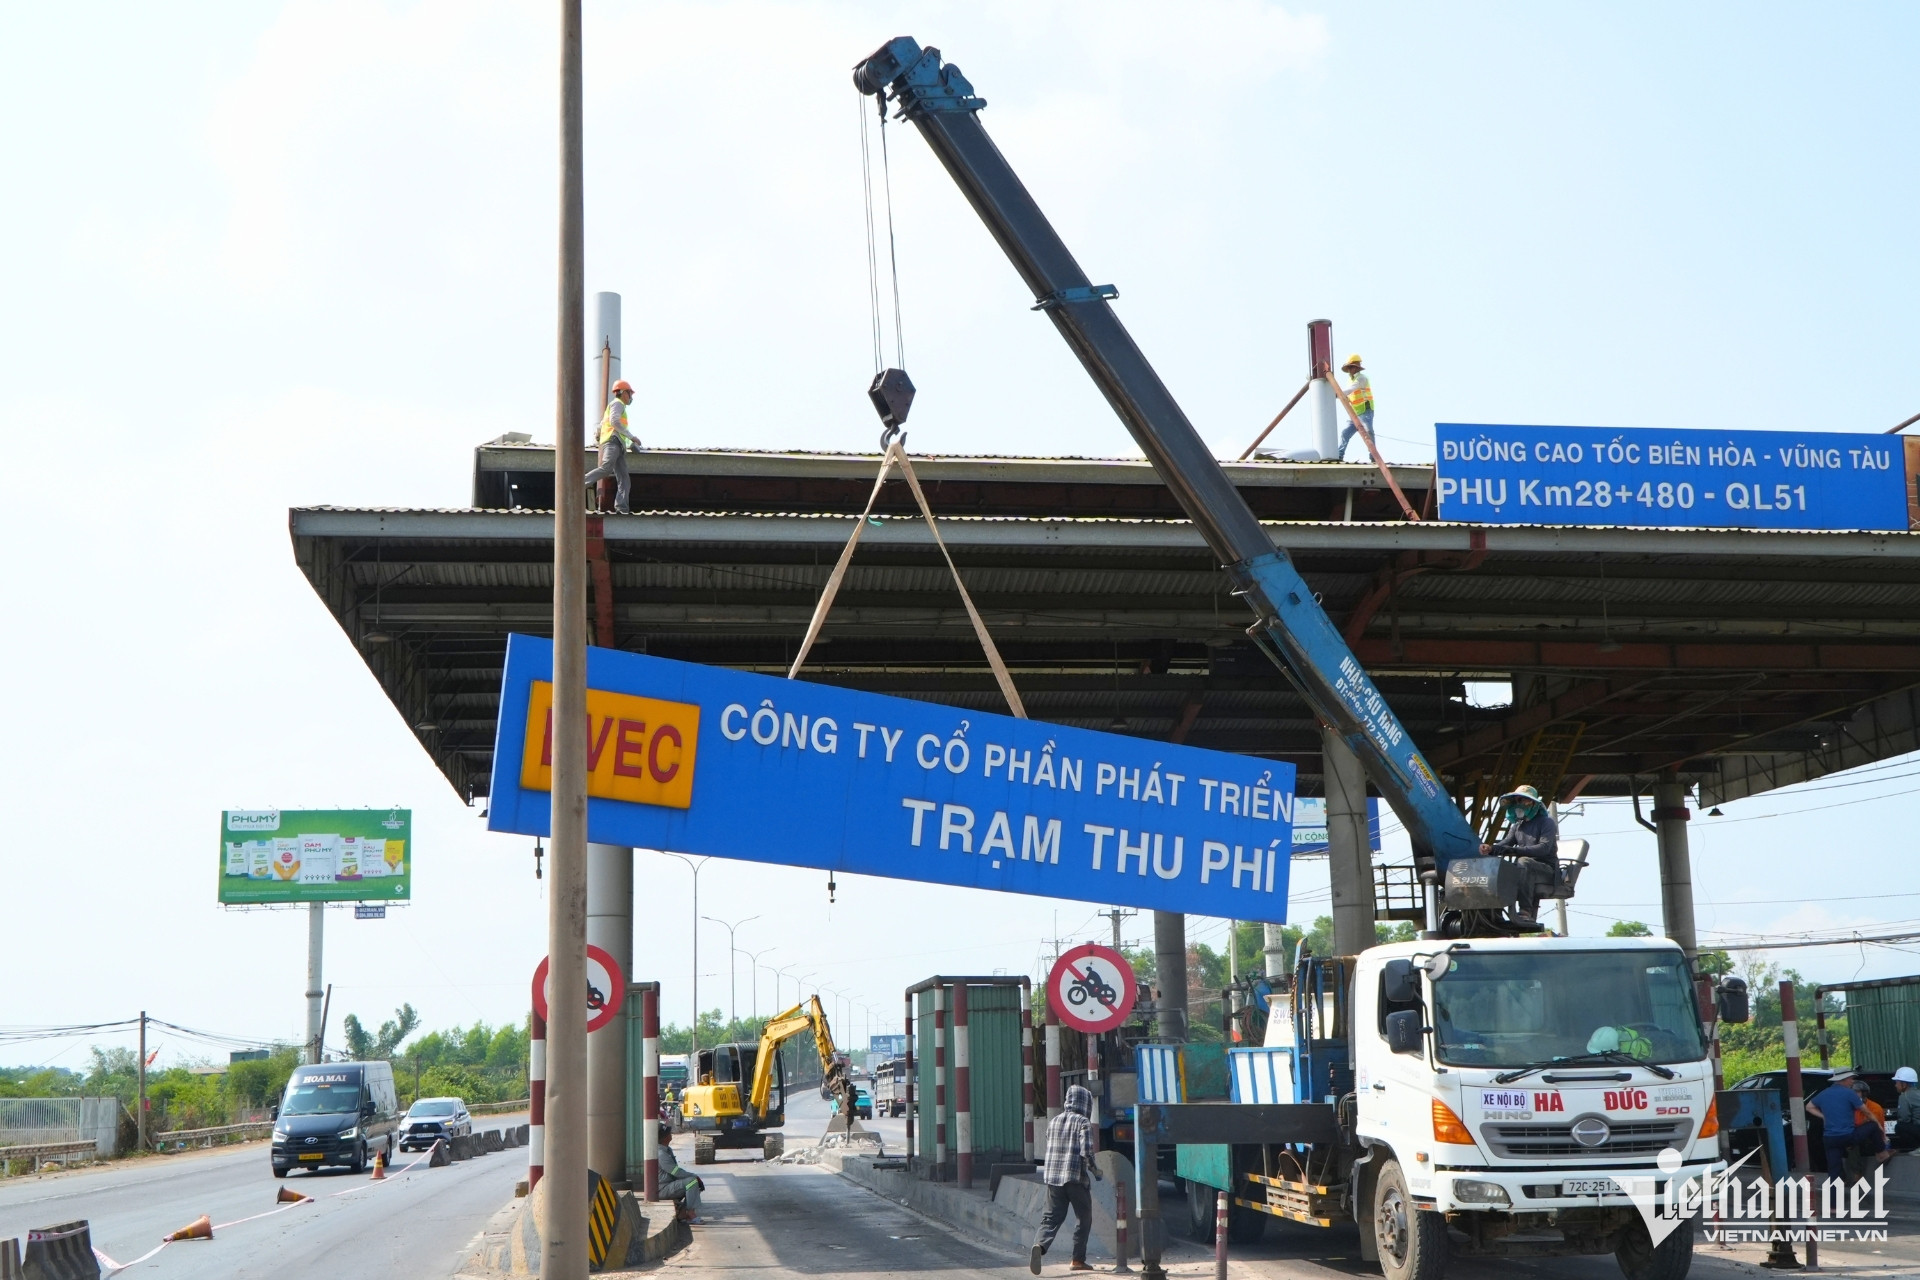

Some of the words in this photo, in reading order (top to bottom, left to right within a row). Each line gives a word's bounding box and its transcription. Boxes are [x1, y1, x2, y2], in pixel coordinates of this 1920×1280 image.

[1443, 435, 1527, 463] ĐƯỜNG
[1534, 442, 1583, 464] CAO
[1592, 436, 1641, 465] TỐC
[1649, 440, 1700, 466] BIÊN
[1708, 440, 1757, 467] HÒA
[1779, 444, 1841, 471] VŨNG
[1849, 445, 1890, 470] TÀU
[1438, 477, 1507, 513] PHỤ
[1520, 479, 1695, 509] Km28+480
[1725, 483, 1807, 511] QL51
[541, 708, 682, 784] VEC
[720, 699, 838, 754] CÔNG
[853, 722, 903, 763] TY
[916, 719, 971, 774] CỔ
[984, 739, 1083, 792] PHẦN
[1096, 761, 1186, 807] PHÁT
[1199, 770, 1293, 823] TRIỂN
[902, 798, 1062, 869] TRẠM
[1083, 824, 1184, 880] THU
[1200, 839, 1282, 893] PHÍ
[303, 1075, 324, 1084] HOA
[325, 1074, 347, 1082] MAI
[1483, 1093, 1494, 1105] XE
[1497, 1092, 1511, 1108] NỘI
[1514, 1093, 1525, 1108] BỘ
[1534, 1089, 1564, 1112] HÀ
[1603, 1087, 1648, 1110] ĐỨC
[1656, 1106, 1690, 1115] 500
[1484, 1111, 1533, 1120] HINO
